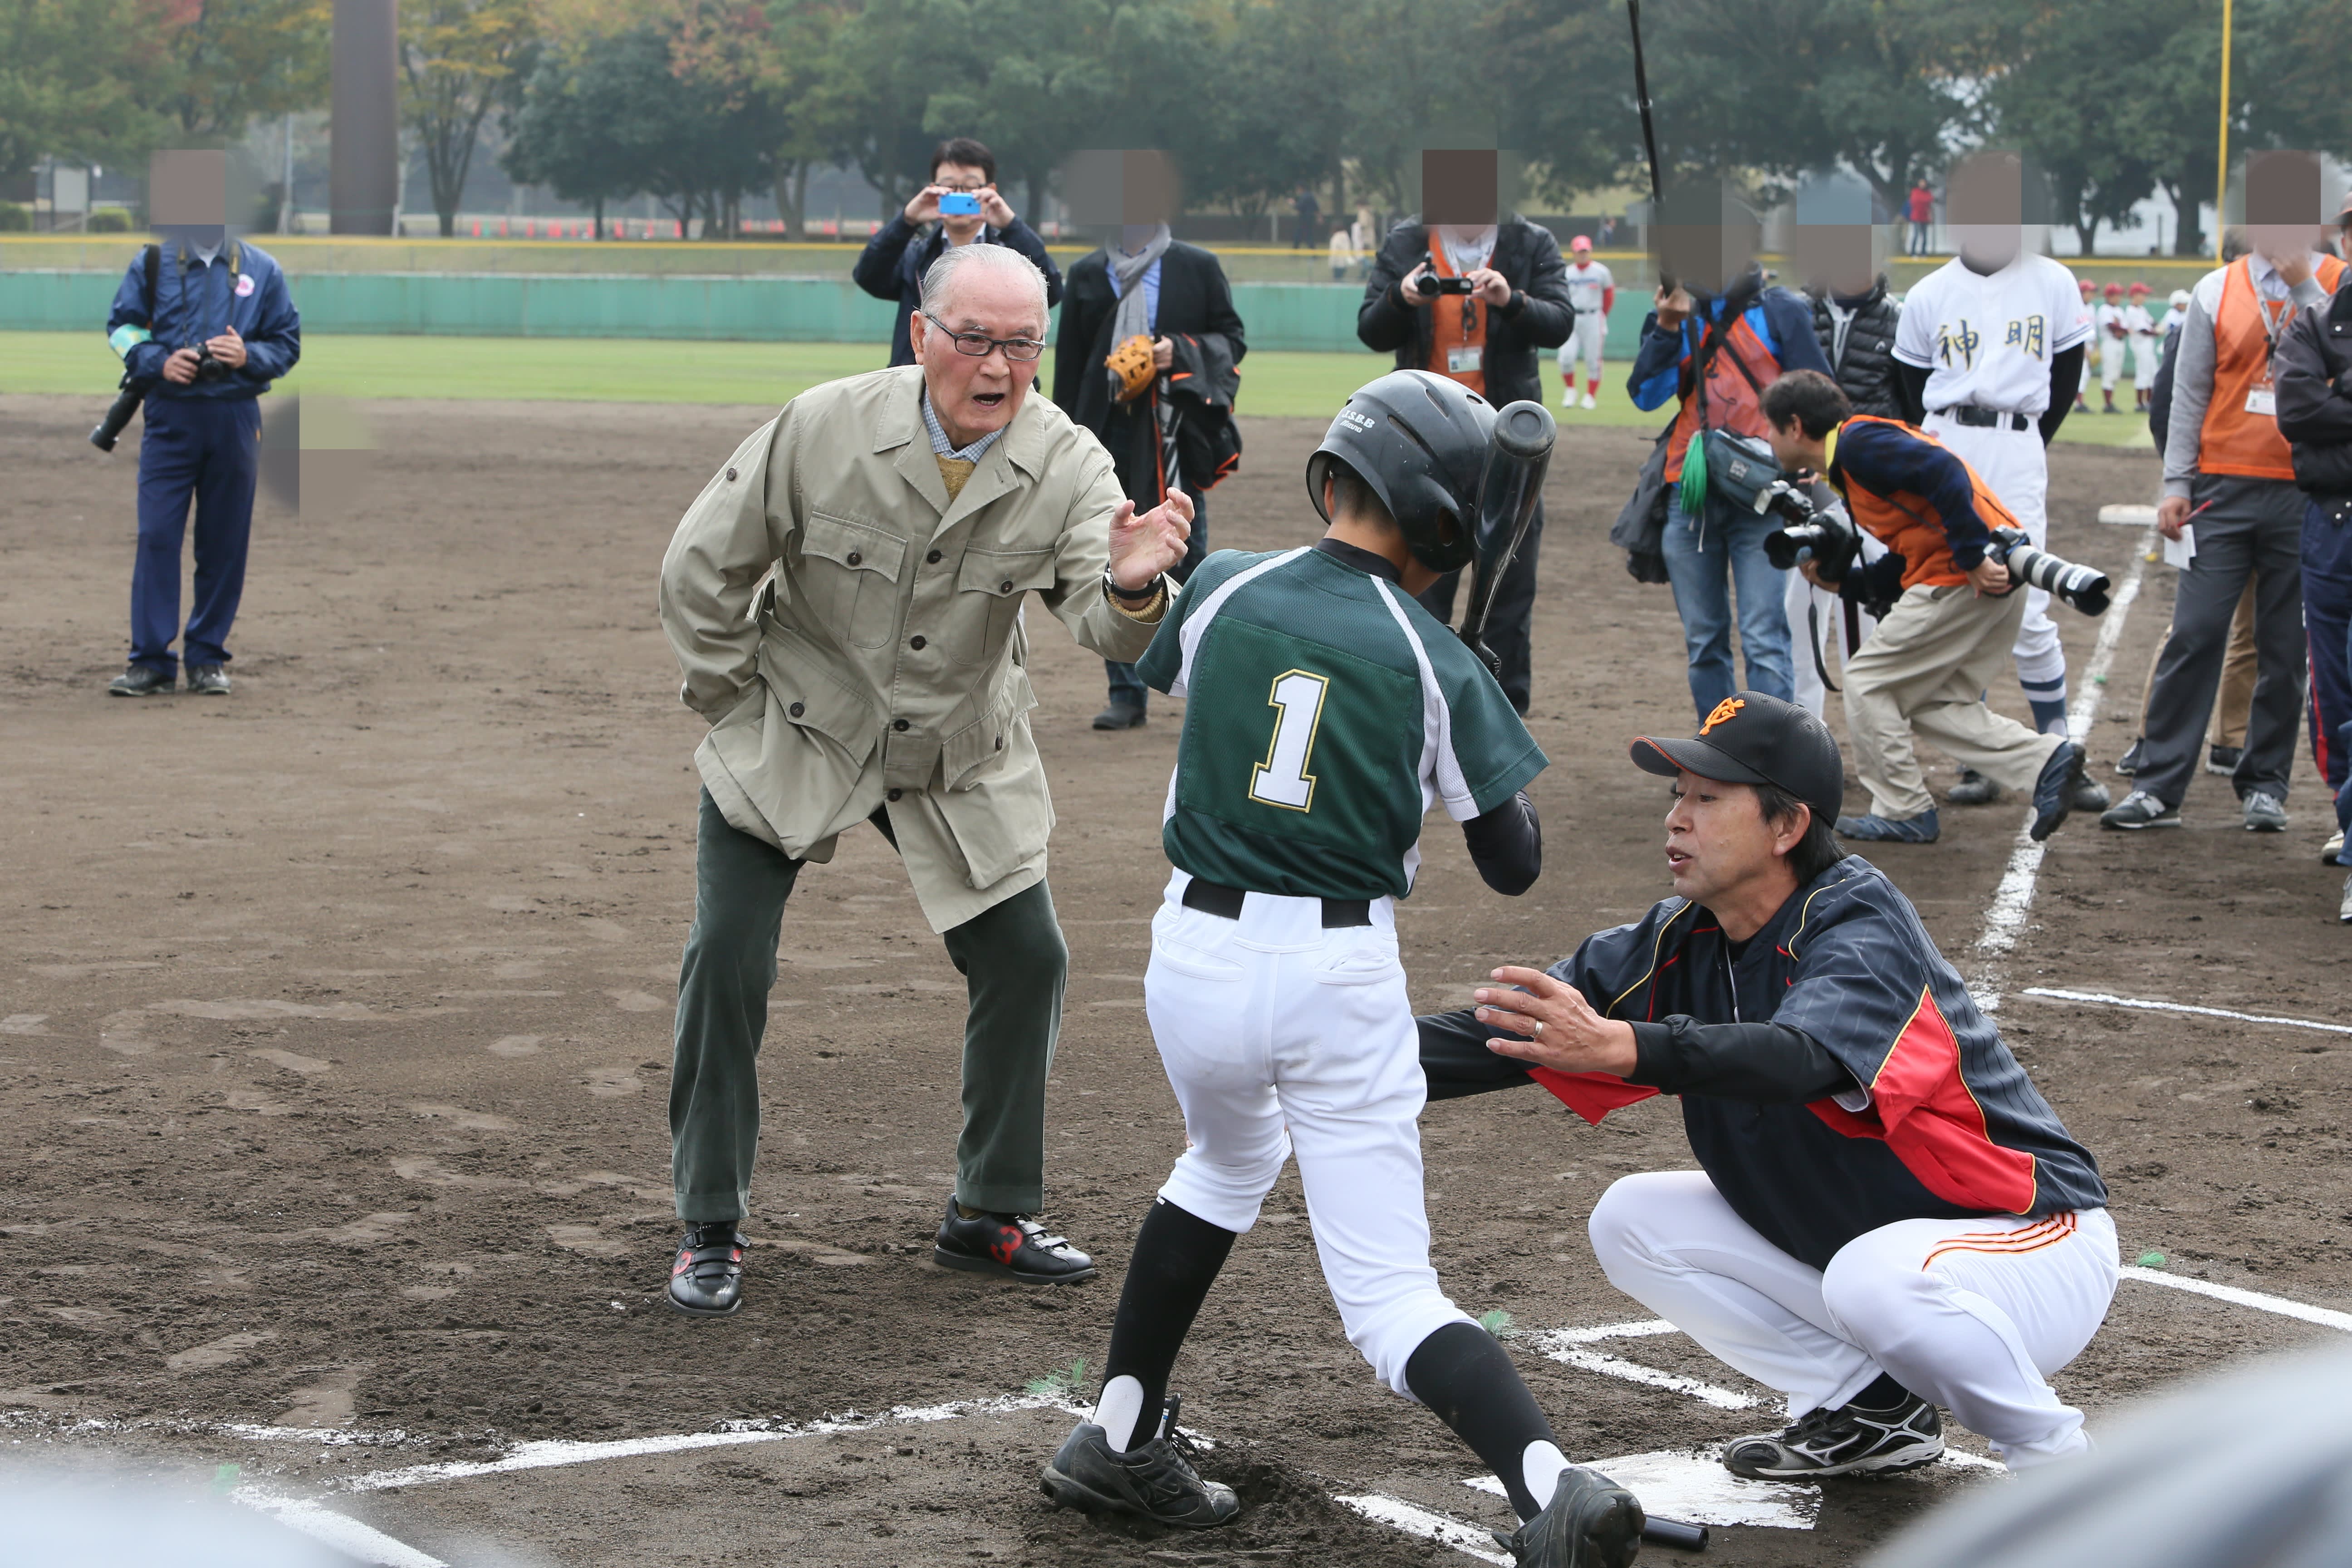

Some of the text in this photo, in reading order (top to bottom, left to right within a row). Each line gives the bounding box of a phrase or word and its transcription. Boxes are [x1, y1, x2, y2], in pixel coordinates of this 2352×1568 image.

[1339, 420, 1363, 433] MIZUNO
[1342, 410, 1375, 428] J.S.B.B
[1248, 668, 1330, 813] 1
[990, 1225, 1024, 1265] 3
